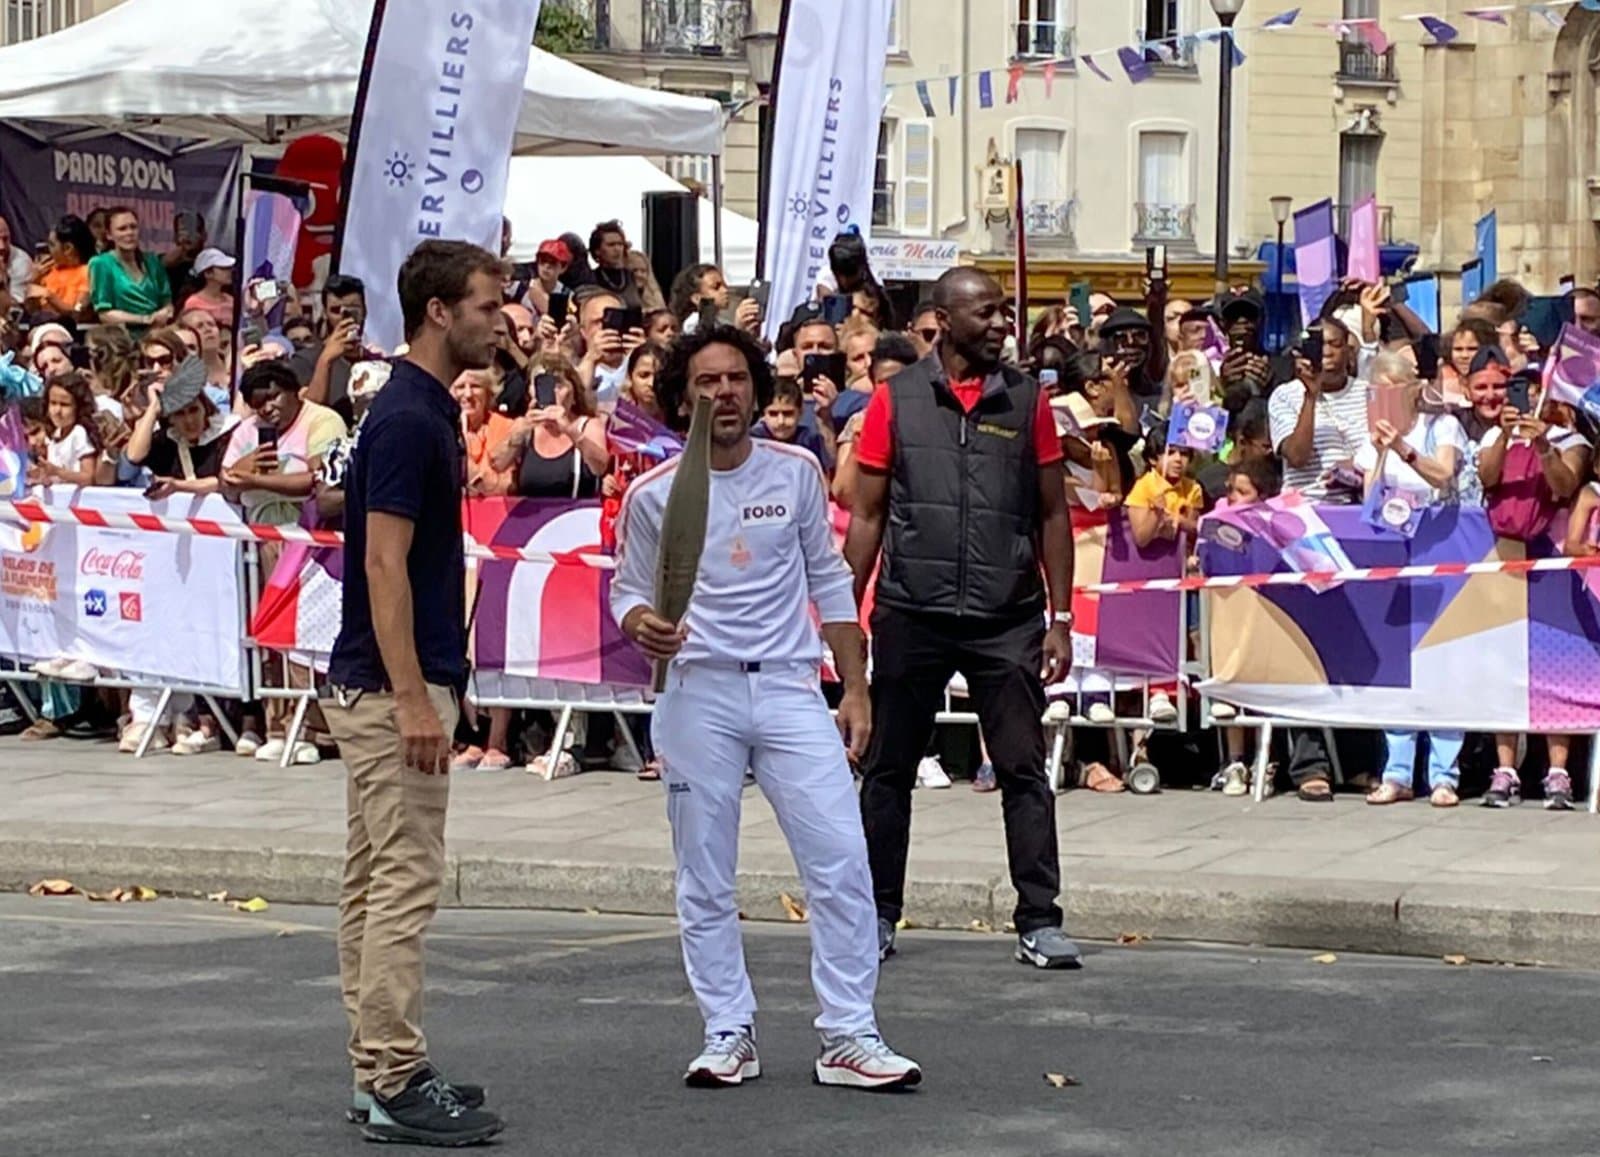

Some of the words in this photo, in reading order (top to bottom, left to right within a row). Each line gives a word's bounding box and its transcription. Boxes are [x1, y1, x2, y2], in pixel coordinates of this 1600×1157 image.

[54, 150, 117, 186] PARIS
[120, 157, 176, 192] 2024
[904, 243, 956, 260] Malik
